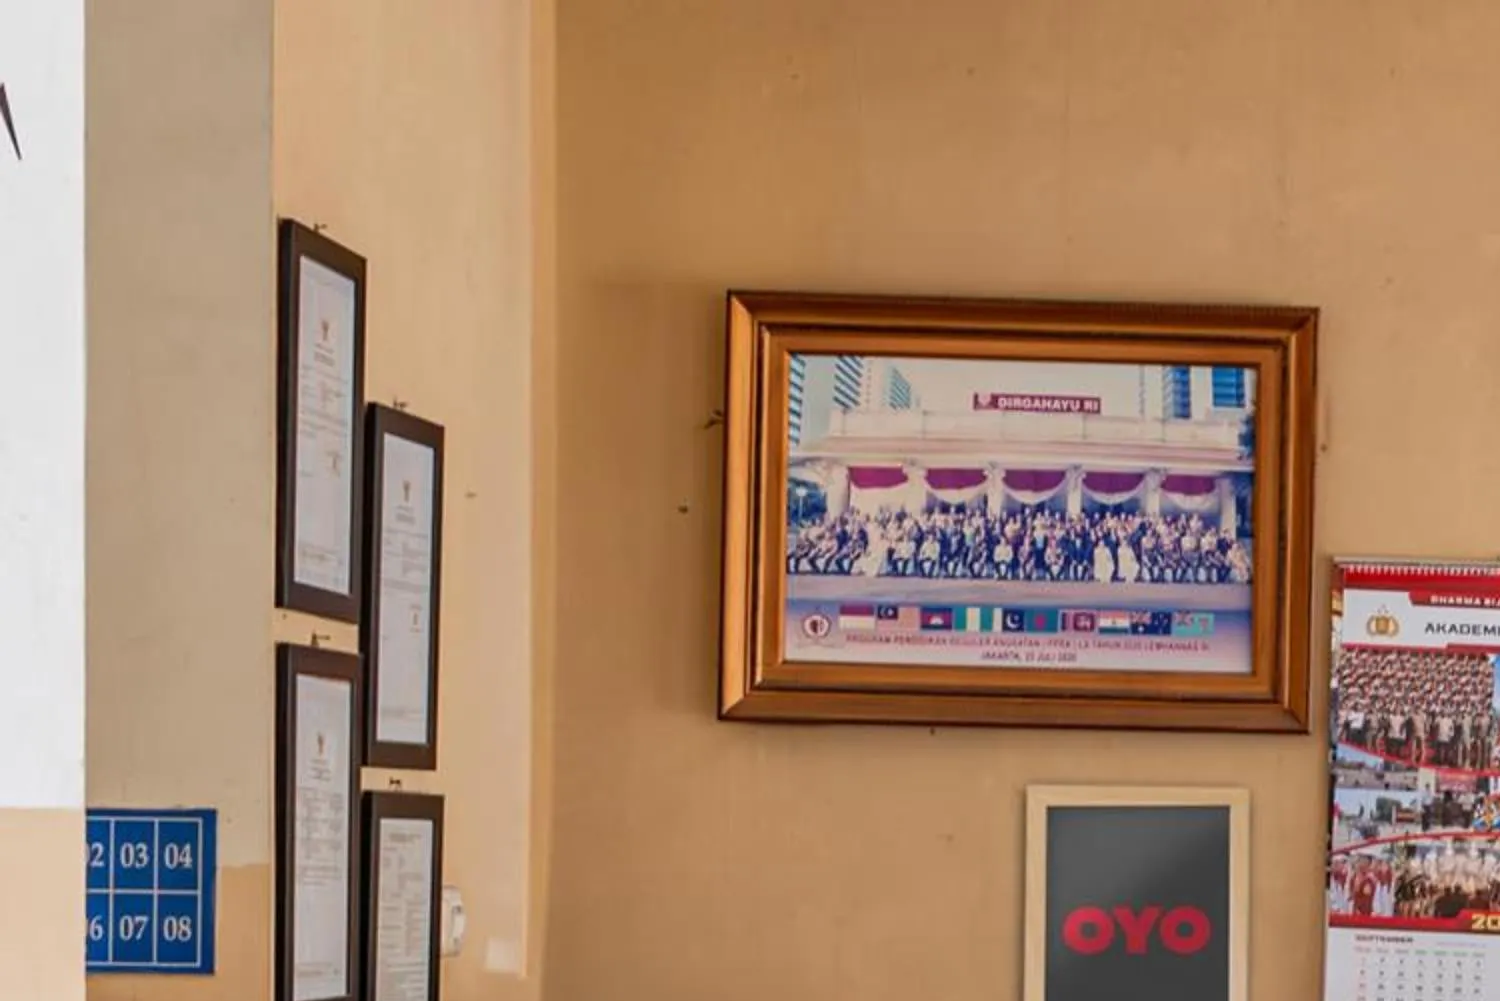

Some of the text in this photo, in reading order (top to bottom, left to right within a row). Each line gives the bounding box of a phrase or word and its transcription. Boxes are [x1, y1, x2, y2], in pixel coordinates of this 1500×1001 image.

[998, 397, 1080, 411] DIRGAHAYU
[86, 843, 193, 869] 2 03 04
[119, 916, 149, 941] 07
[163, 916, 193, 942] 08
[1062, 904, 1212, 955] OYO
